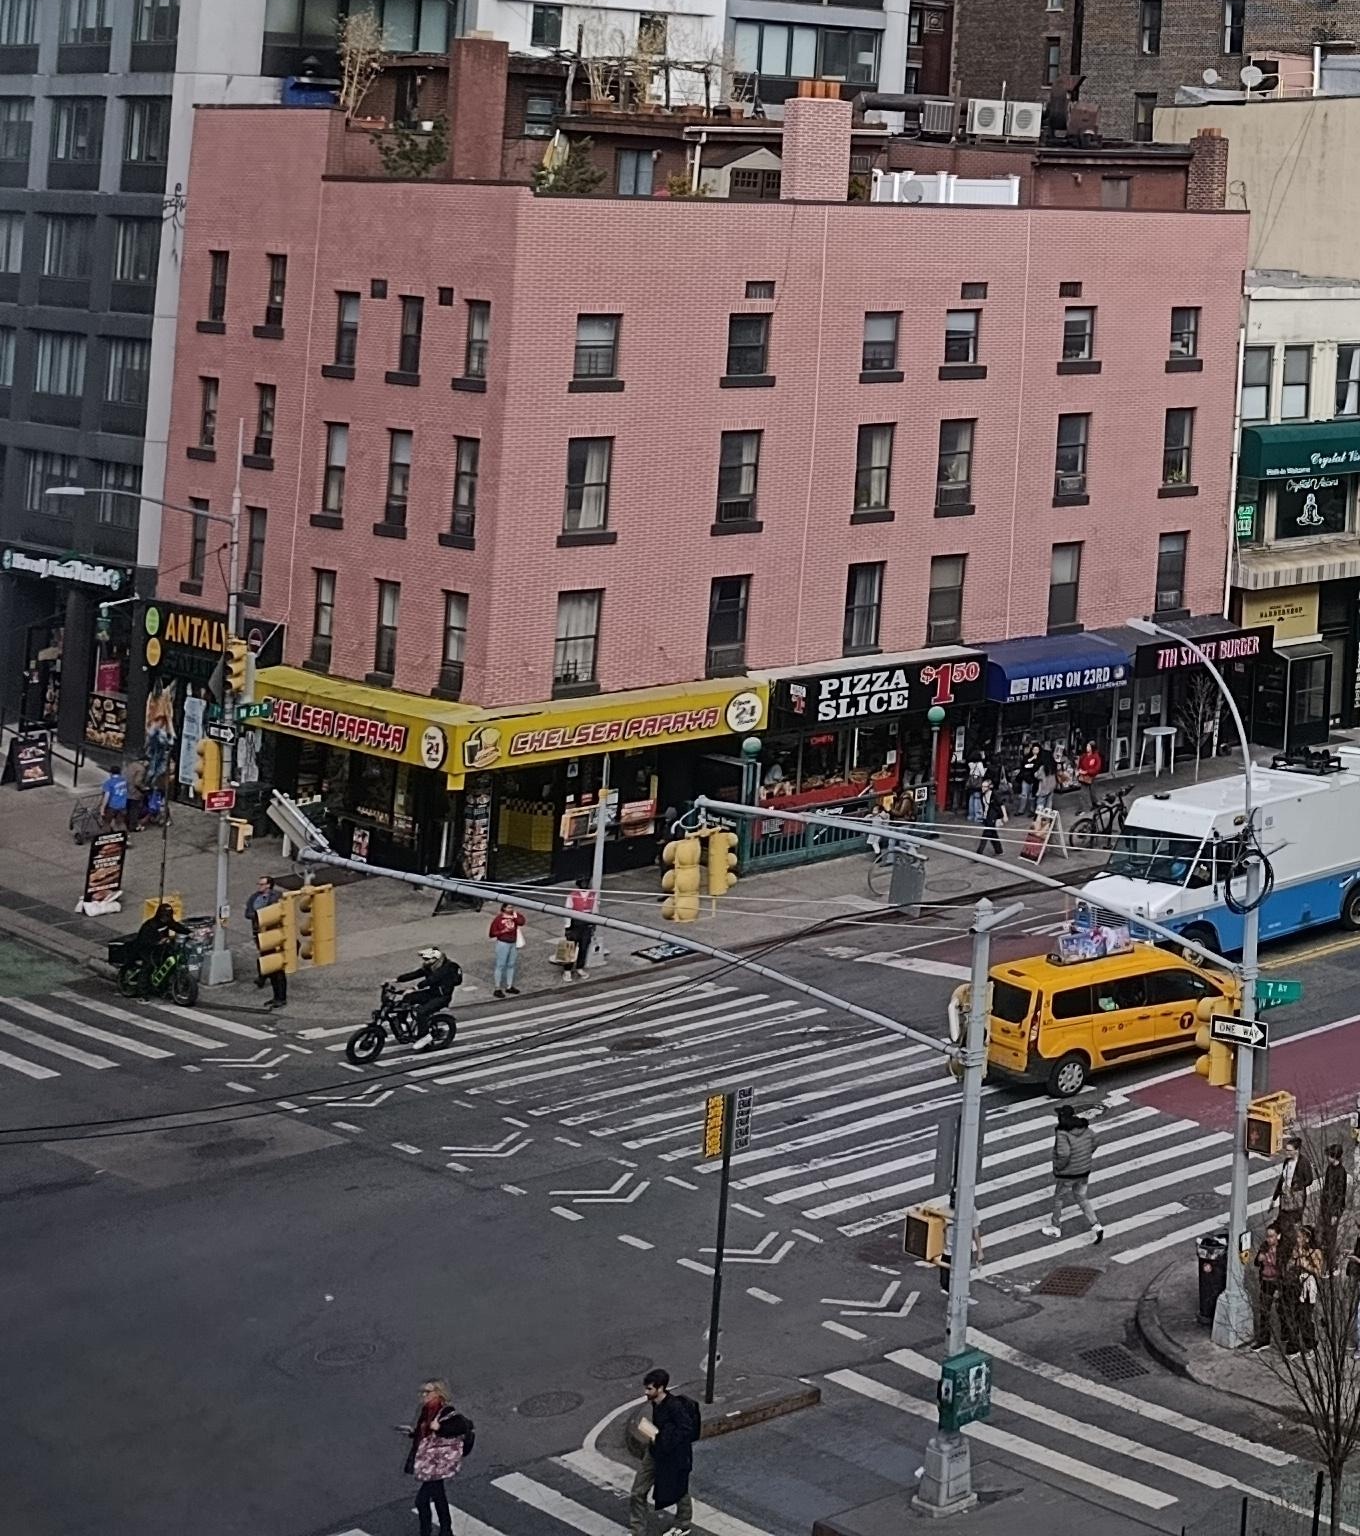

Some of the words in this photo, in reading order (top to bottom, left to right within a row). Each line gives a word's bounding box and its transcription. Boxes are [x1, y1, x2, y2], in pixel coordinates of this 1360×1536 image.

[1310, 451, 1347, 469] Crystal
[1157, 648, 1178, 669] 7TH
[1219, 636, 1260, 659] BURGER
[819, 669, 910, 700] PIZZA
[1031, 673, 1063, 692] NEWS
[1066, 671, 1081, 688] ON
[1083, 667, 1110, 685] 23RD
[241, 708, 247, 718] W
[249, 705, 260, 717] 23
[818, 690, 909, 722] SLICE
[334, 714, 406, 753] PAPAYA
[511, 719, 621, 757] CHELSEA
[625, 708, 720, 740] PAPAYA
[426, 742, 440, 755] 24
[1266, 983, 1274, 997] 7
[1219, 1022, 1236, 1033] ONE
[1243, 1027, 1260, 1039] WAY
